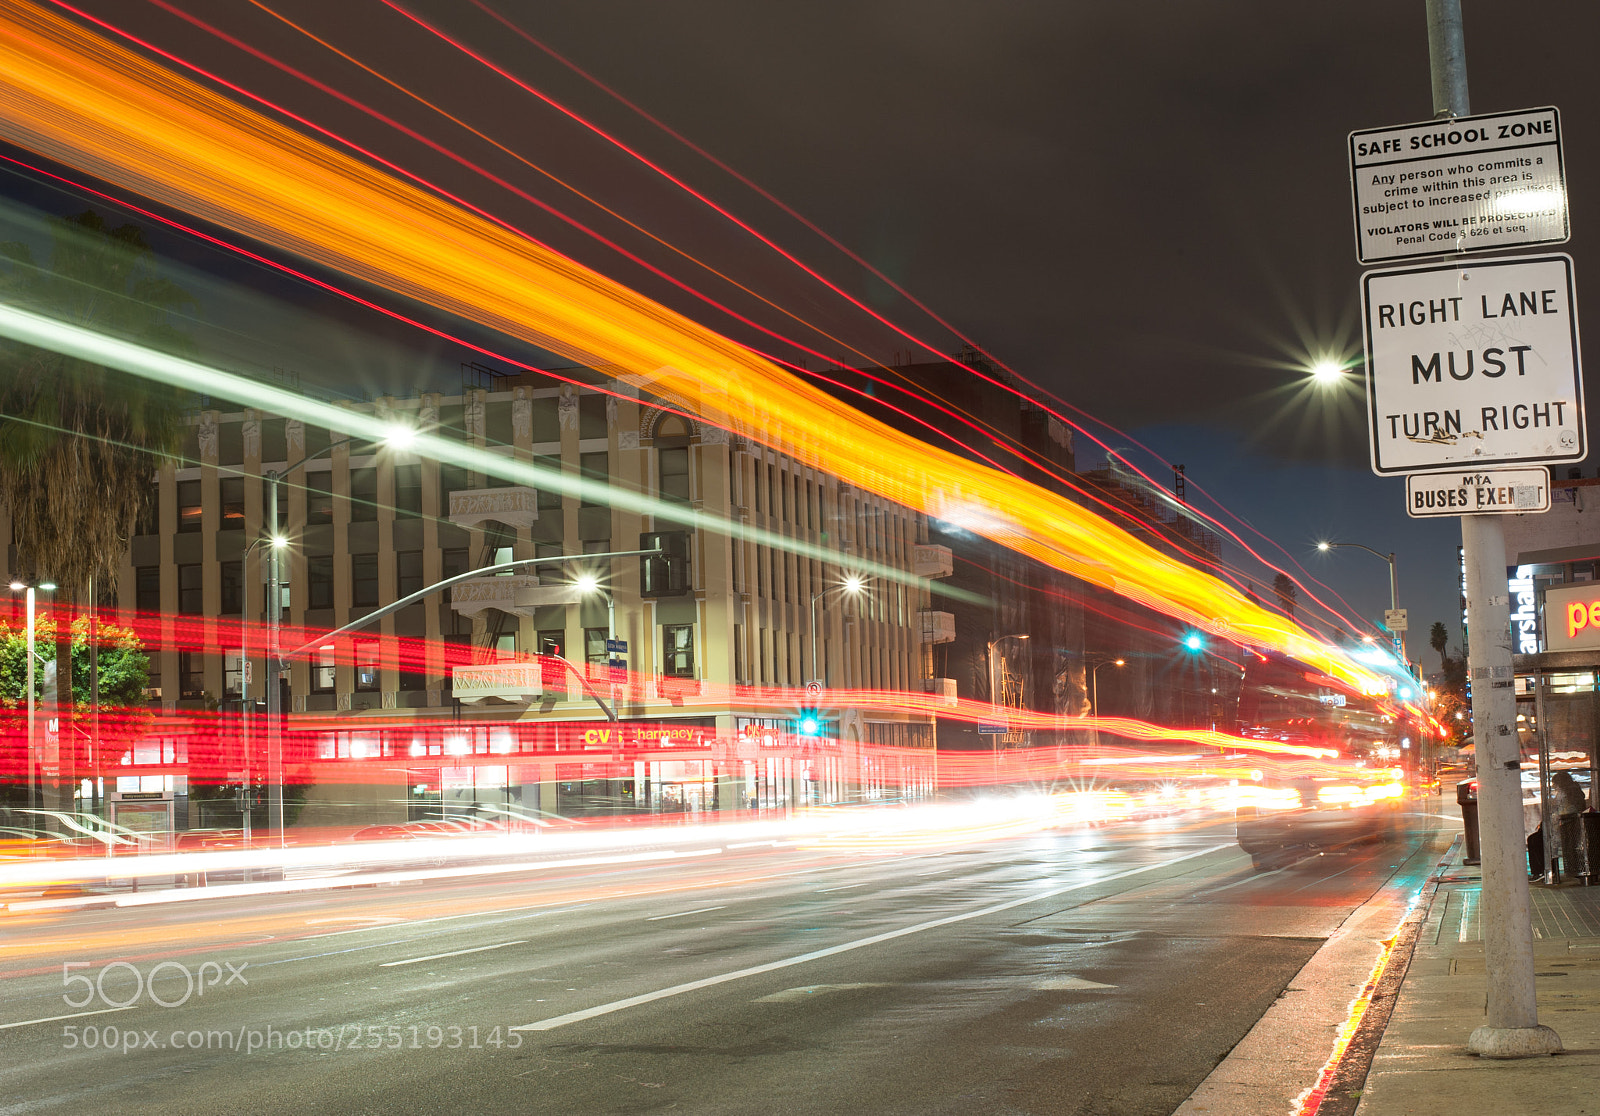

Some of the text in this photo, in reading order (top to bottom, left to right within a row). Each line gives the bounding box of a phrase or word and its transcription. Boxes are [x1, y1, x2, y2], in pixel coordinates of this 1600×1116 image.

[1358, 120, 1553, 157] SAFE SCHOOL ZONE
[1372, 156, 1543, 186] Any person who commits a
[1384, 171, 1533, 198] crime within this area is
[1363, 199, 1409, 214] subject
[1412, 199, 1425, 208] to
[1429, 190, 1491, 207] increased
[1367, 222, 1430, 237] VIOLATORS
[1432, 218, 1459, 229] WILL
[1462, 216, 1477, 226] BE
[1396, 234, 1425, 246] Penal
[1428, 231, 1457, 243] Code
[1470, 227, 1489, 237] 626
[1492, 225, 1503, 235] et
[1506, 224, 1529, 234] seq.
[1378, 289, 1558, 329] RIGHT LANE
[1411, 344, 1532, 385] MUST
[1386, 401, 1567, 439] TURN RIGHT
[1462, 475, 1492, 486] MTA
[1414, 488, 1468, 509] BUSES
